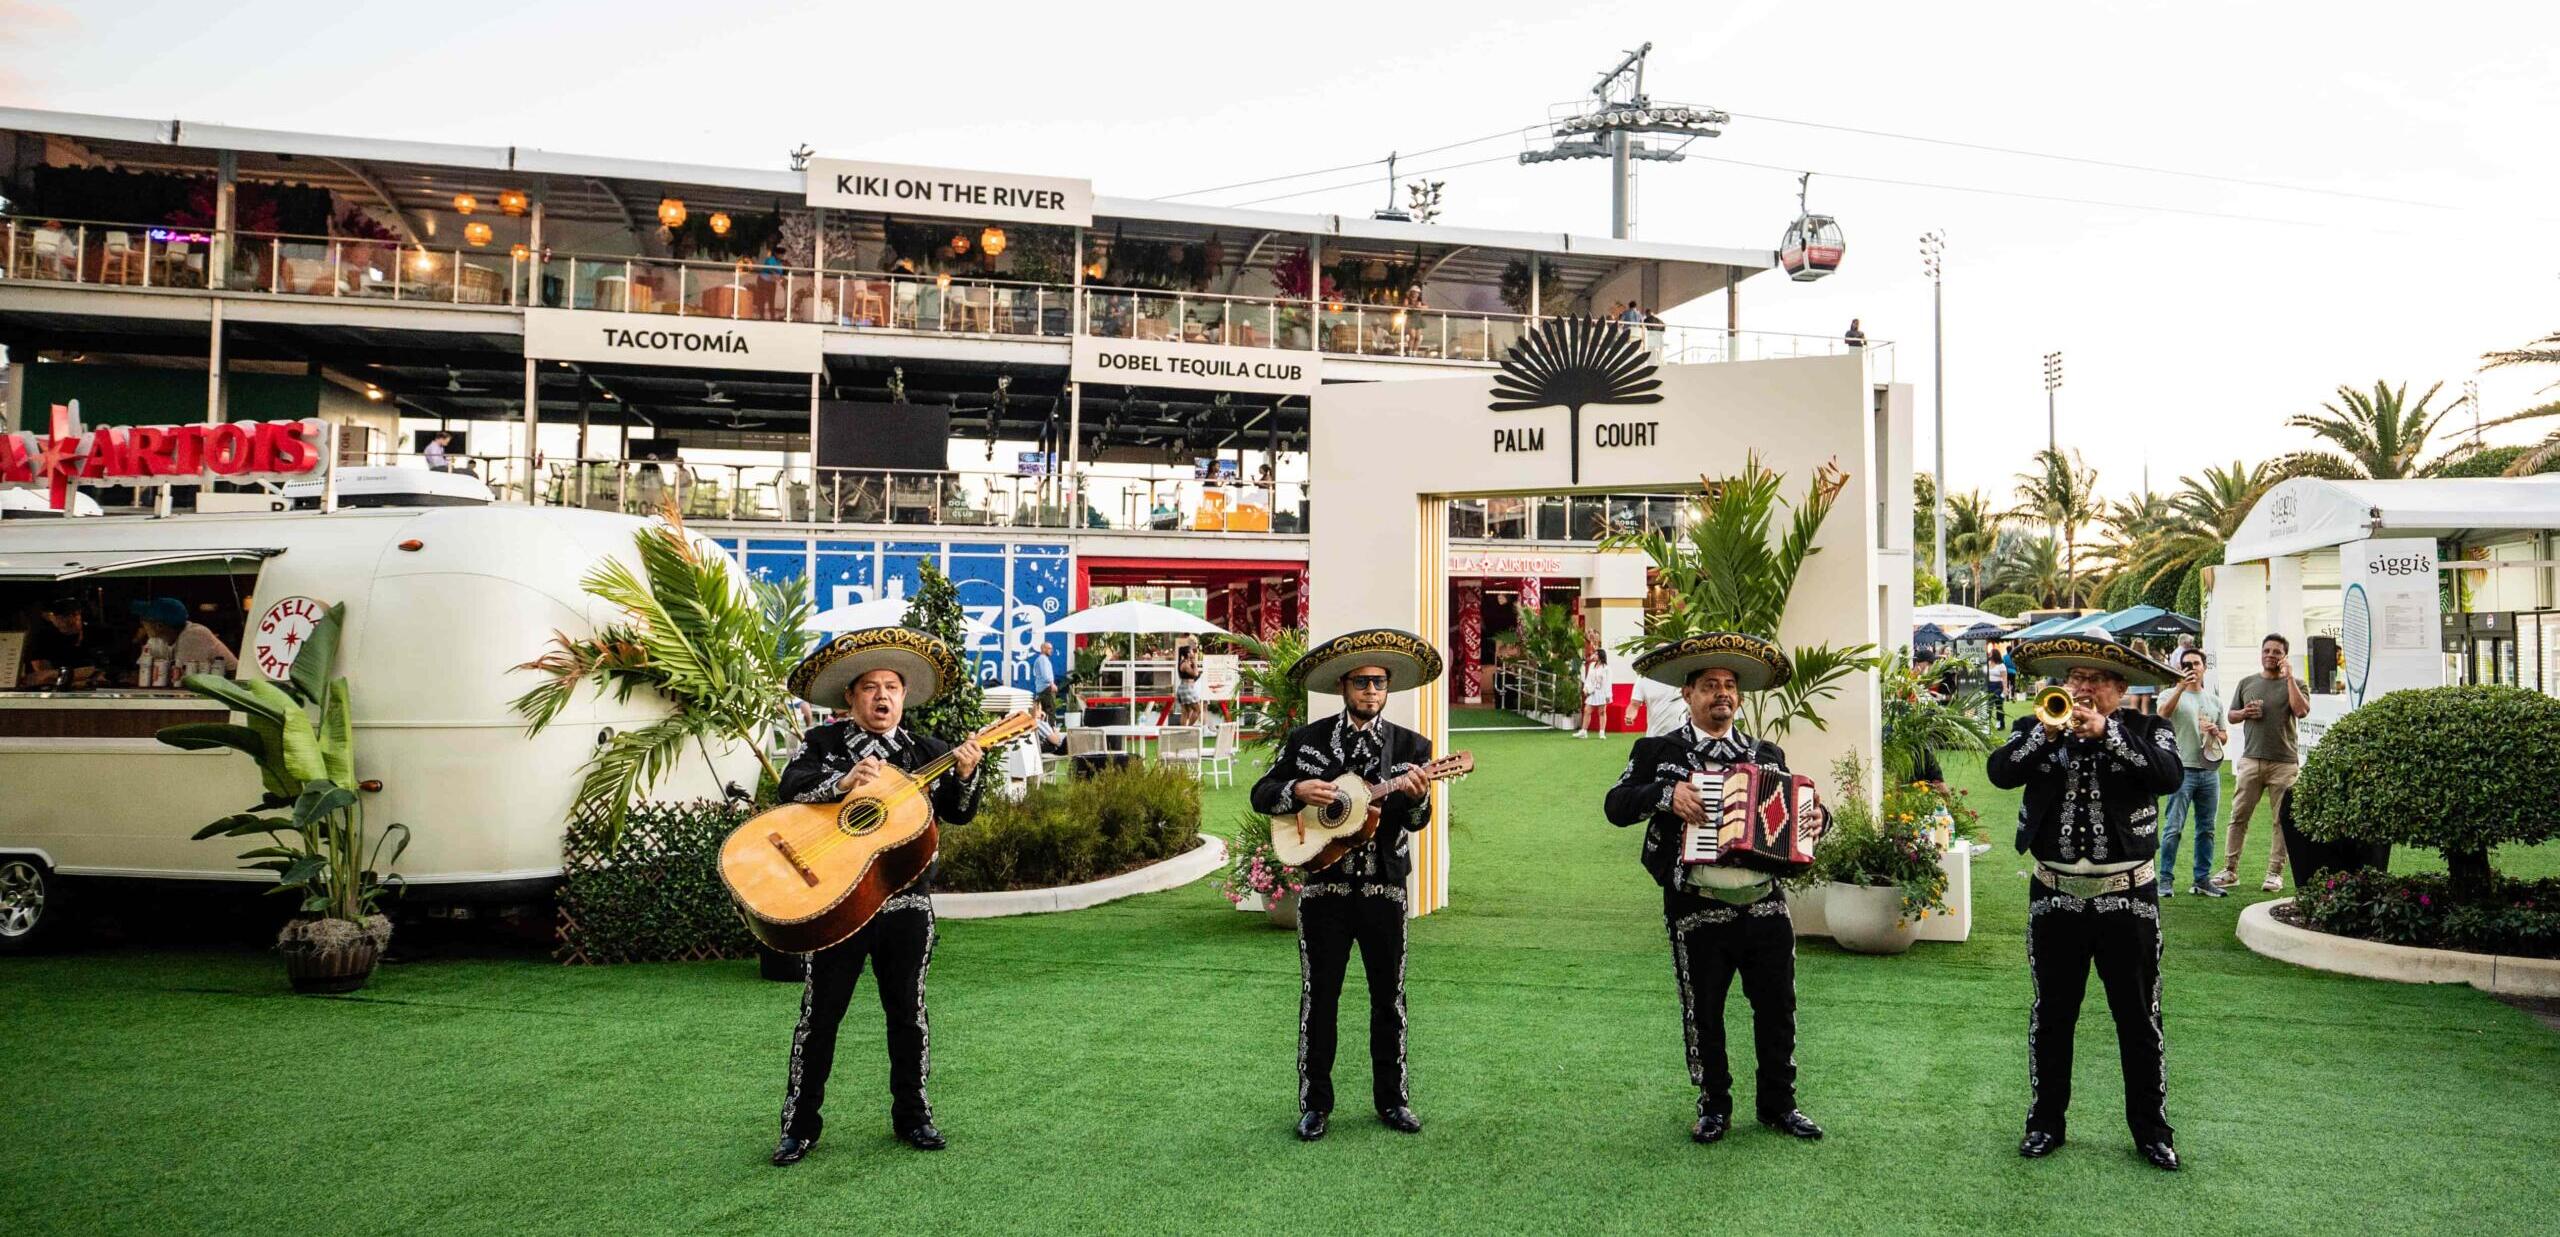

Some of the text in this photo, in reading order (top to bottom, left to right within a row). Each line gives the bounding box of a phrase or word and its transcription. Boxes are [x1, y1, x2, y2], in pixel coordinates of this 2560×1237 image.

[836, 174, 1065, 210] KIKI ON THE RIVER
[602, 328, 749, 354] TACOTOMÍA
[1098, 352, 1302, 381] DOBEL TEQUILA CLUB
[80, 420, 322, 478] ARTOIS
[1494, 421, 1659, 453] PALM COURT
[2271, 487, 2298, 525] siggi's
[1496, 557, 1562, 572] ARTOIS
[2369, 553, 2431, 576] siggi's
